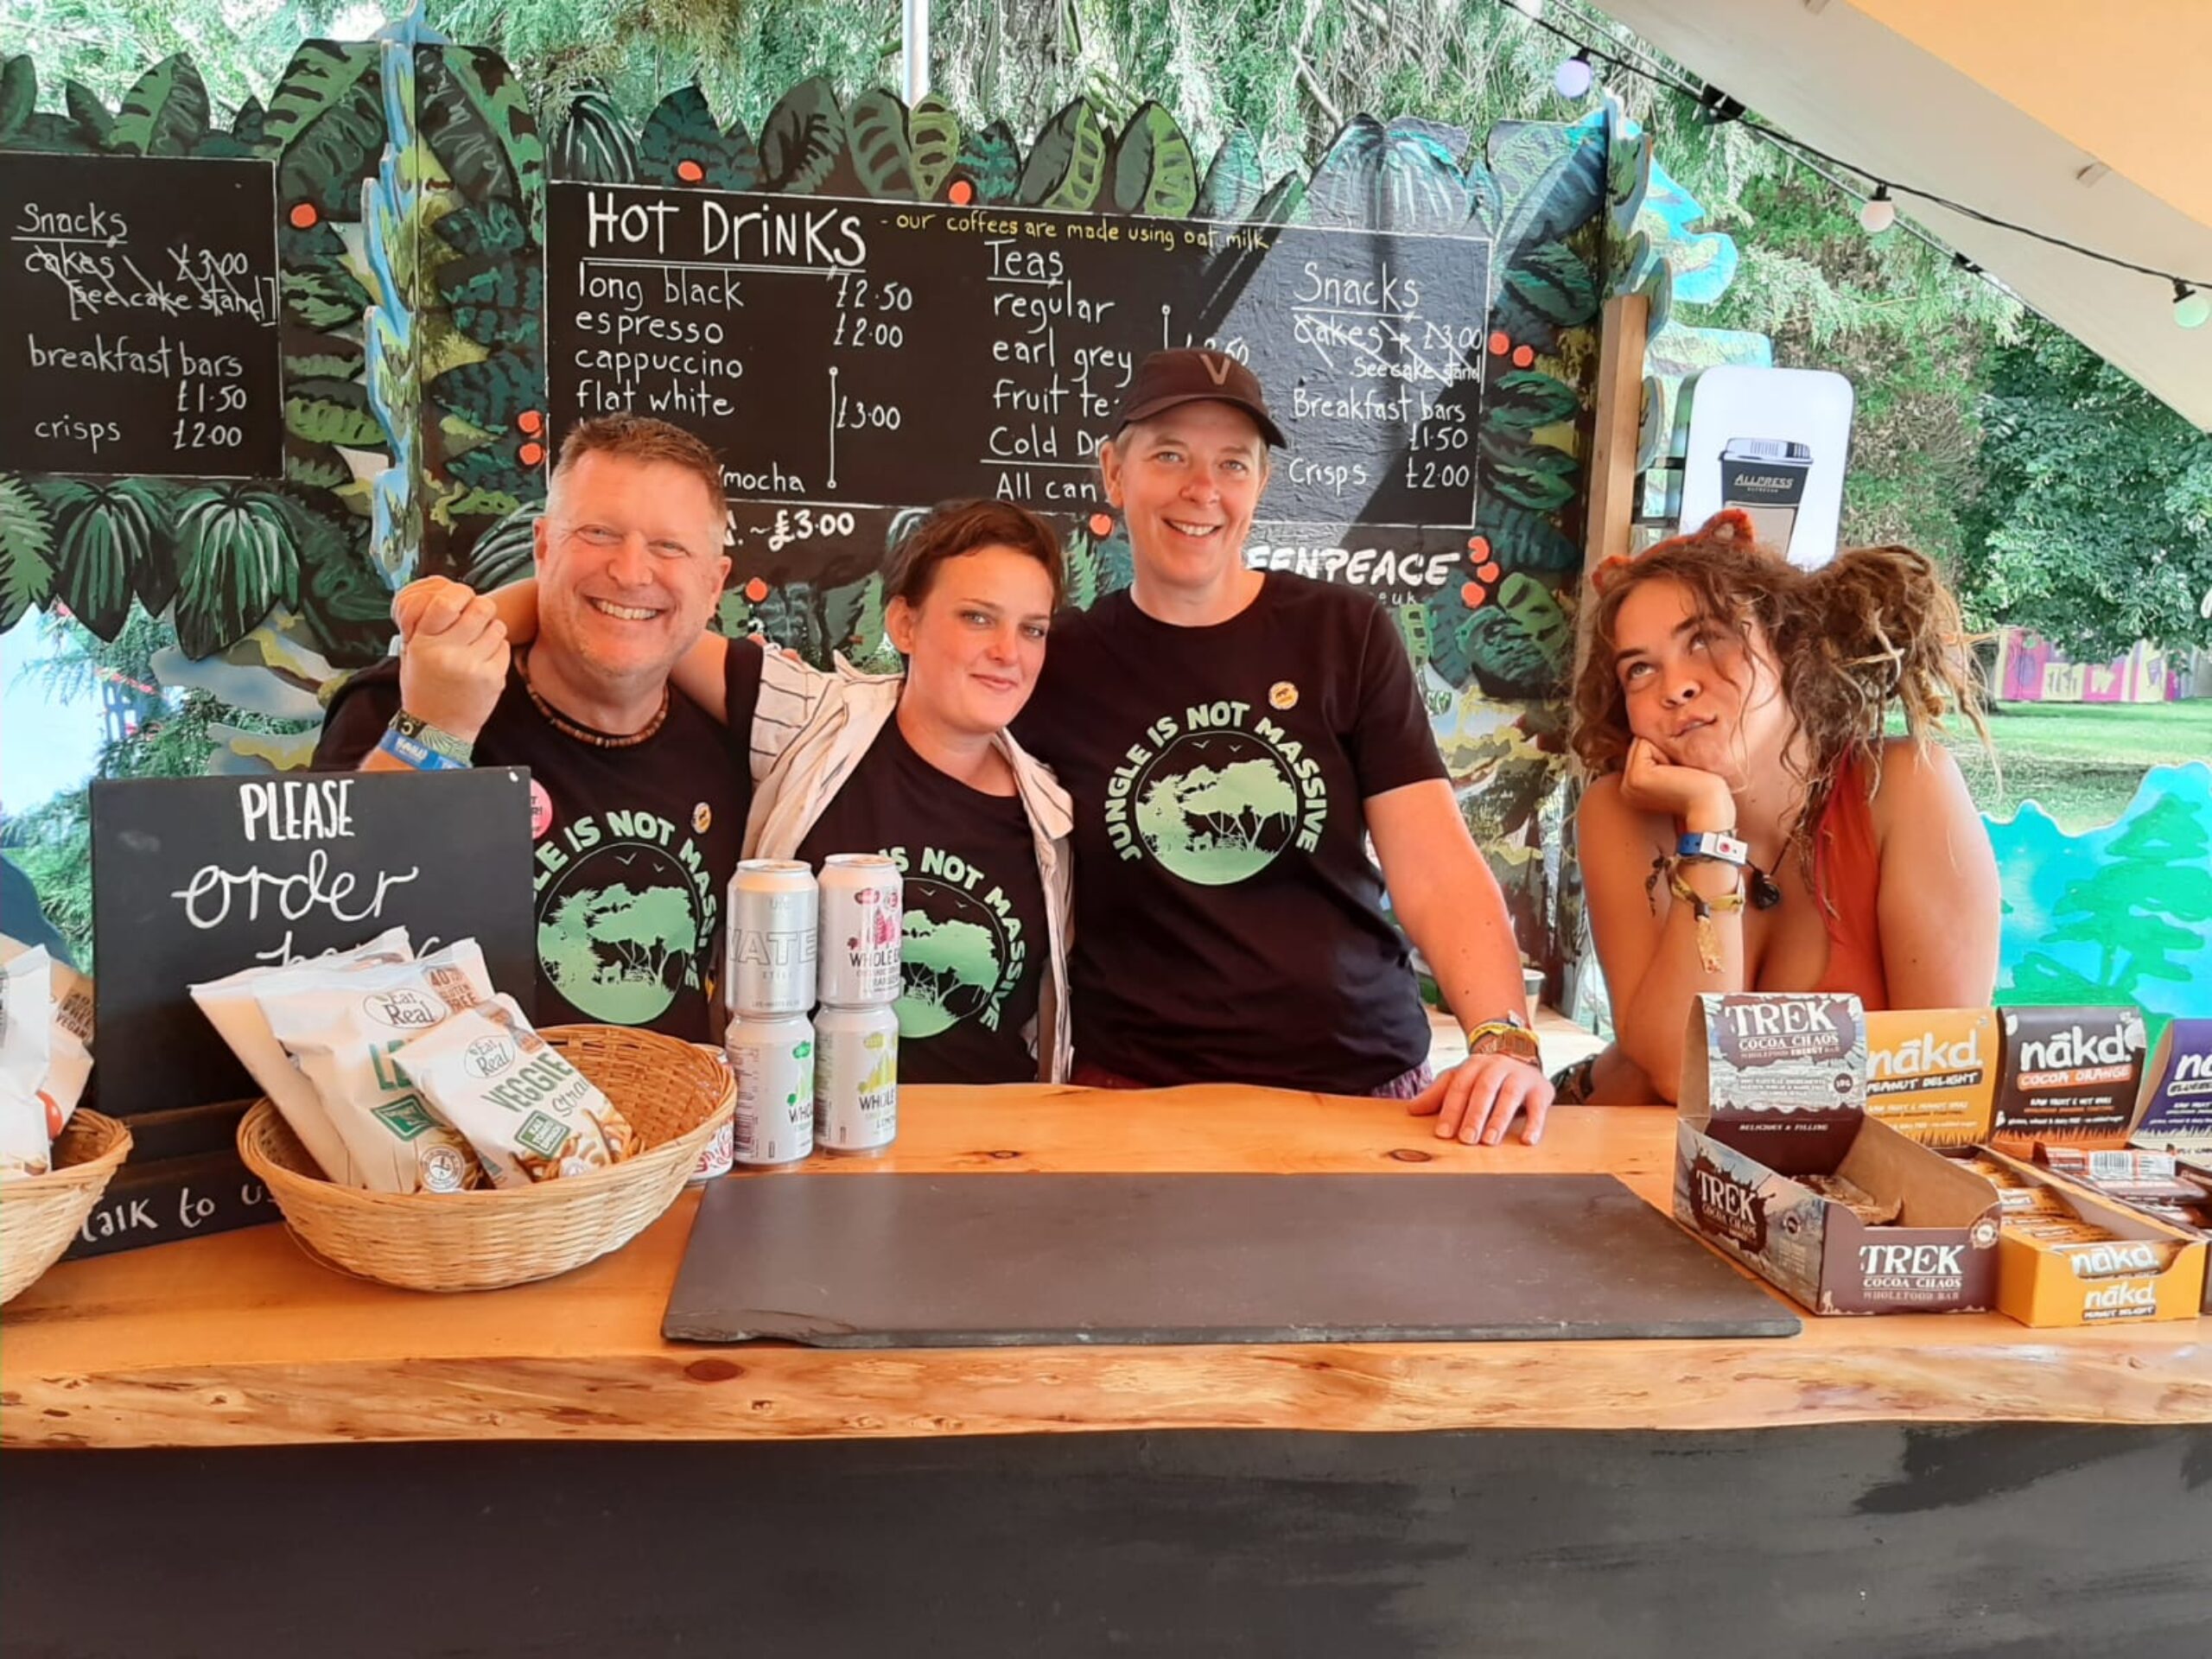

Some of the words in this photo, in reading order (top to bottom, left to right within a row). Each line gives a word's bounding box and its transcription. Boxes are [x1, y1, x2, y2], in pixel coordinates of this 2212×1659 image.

[16, 202, 128, 238] Snacks
[588, 192, 679, 254] HOT
[896, 213, 936, 231] our
[947, 211, 1018, 236] coffees
[1026, 221, 1058, 238] are
[1067, 217, 1120, 243] made
[1128, 226, 1174, 251] using
[1225, 227, 1270, 251] milk
[984, 238, 1064, 277] Teas
[579, 261, 644, 312] long
[664, 267, 745, 310] black
[836, 274, 914, 311] £2.50
[1293, 261, 1420, 313] Snacks
[994, 279, 1116, 334] regular
[575, 310, 724, 345] espresso
[833, 313, 904, 347] £2.00
[29, 334, 173, 378] breakfast
[179, 341, 244, 377] bars
[575, 348, 744, 384] cappuccino
[994, 326, 1056, 368] earl
[1071, 346, 1133, 388] grey
[1199, 353, 1232, 385] V
[177, 380, 247, 413] £1.50
[576, 378, 636, 413] flat
[649, 378, 735, 417] white
[836, 396, 901, 429] £3.00
[1080, 380, 1120, 418] te
[1293, 385, 1414, 423] Breakfast
[1420, 391, 1467, 423] bars
[34, 415, 121, 454] crisps
[173, 419, 243, 450] £2.00
[988, 424, 1058, 457] Cold
[1408, 423, 1469, 452] £1.50
[996, 472, 1032, 500] All
[1045, 481, 1112, 504] can
[1288, 457, 1368, 497] Crisps
[1406, 456, 1470, 489] £2.00
[1104, 744, 1153, 861] JUNGLE
[1147, 715, 1179, 747] IS
[1185, 701, 1251, 730] NOT
[1254, 716, 1328, 854] MASSIVE
[238, 779, 355, 842] PLEASE
[563, 815, 601, 854] IS
[606, 810, 676, 847] NOT
[171, 849, 420, 930] order
[920, 847, 984, 891] NOT
[983, 886, 1026, 1033] MASSIVE
[383, 1000, 435, 1026] Real
[389, 991, 417, 1005] Eat
[1725, 1000, 1839, 1037] TREK
[475, 1045, 511, 1077] Real
[478, 1039, 499, 1056] Eat
[1738, 1038, 1787, 1051] COCOA
[1791, 1033, 1840, 1047] CHAOS
[480, 1052, 575, 1114] VEGGIE
[2020, 1071, 2069, 1087] COCOA
[179, 1186, 215, 1229] to
[1696, 1169, 1758, 1225] TREK
[1859, 1244, 1966, 1274] TREK
[1863, 1277, 1910, 1288] COCOA
[1916, 1277, 1962, 1288] CHAOS
